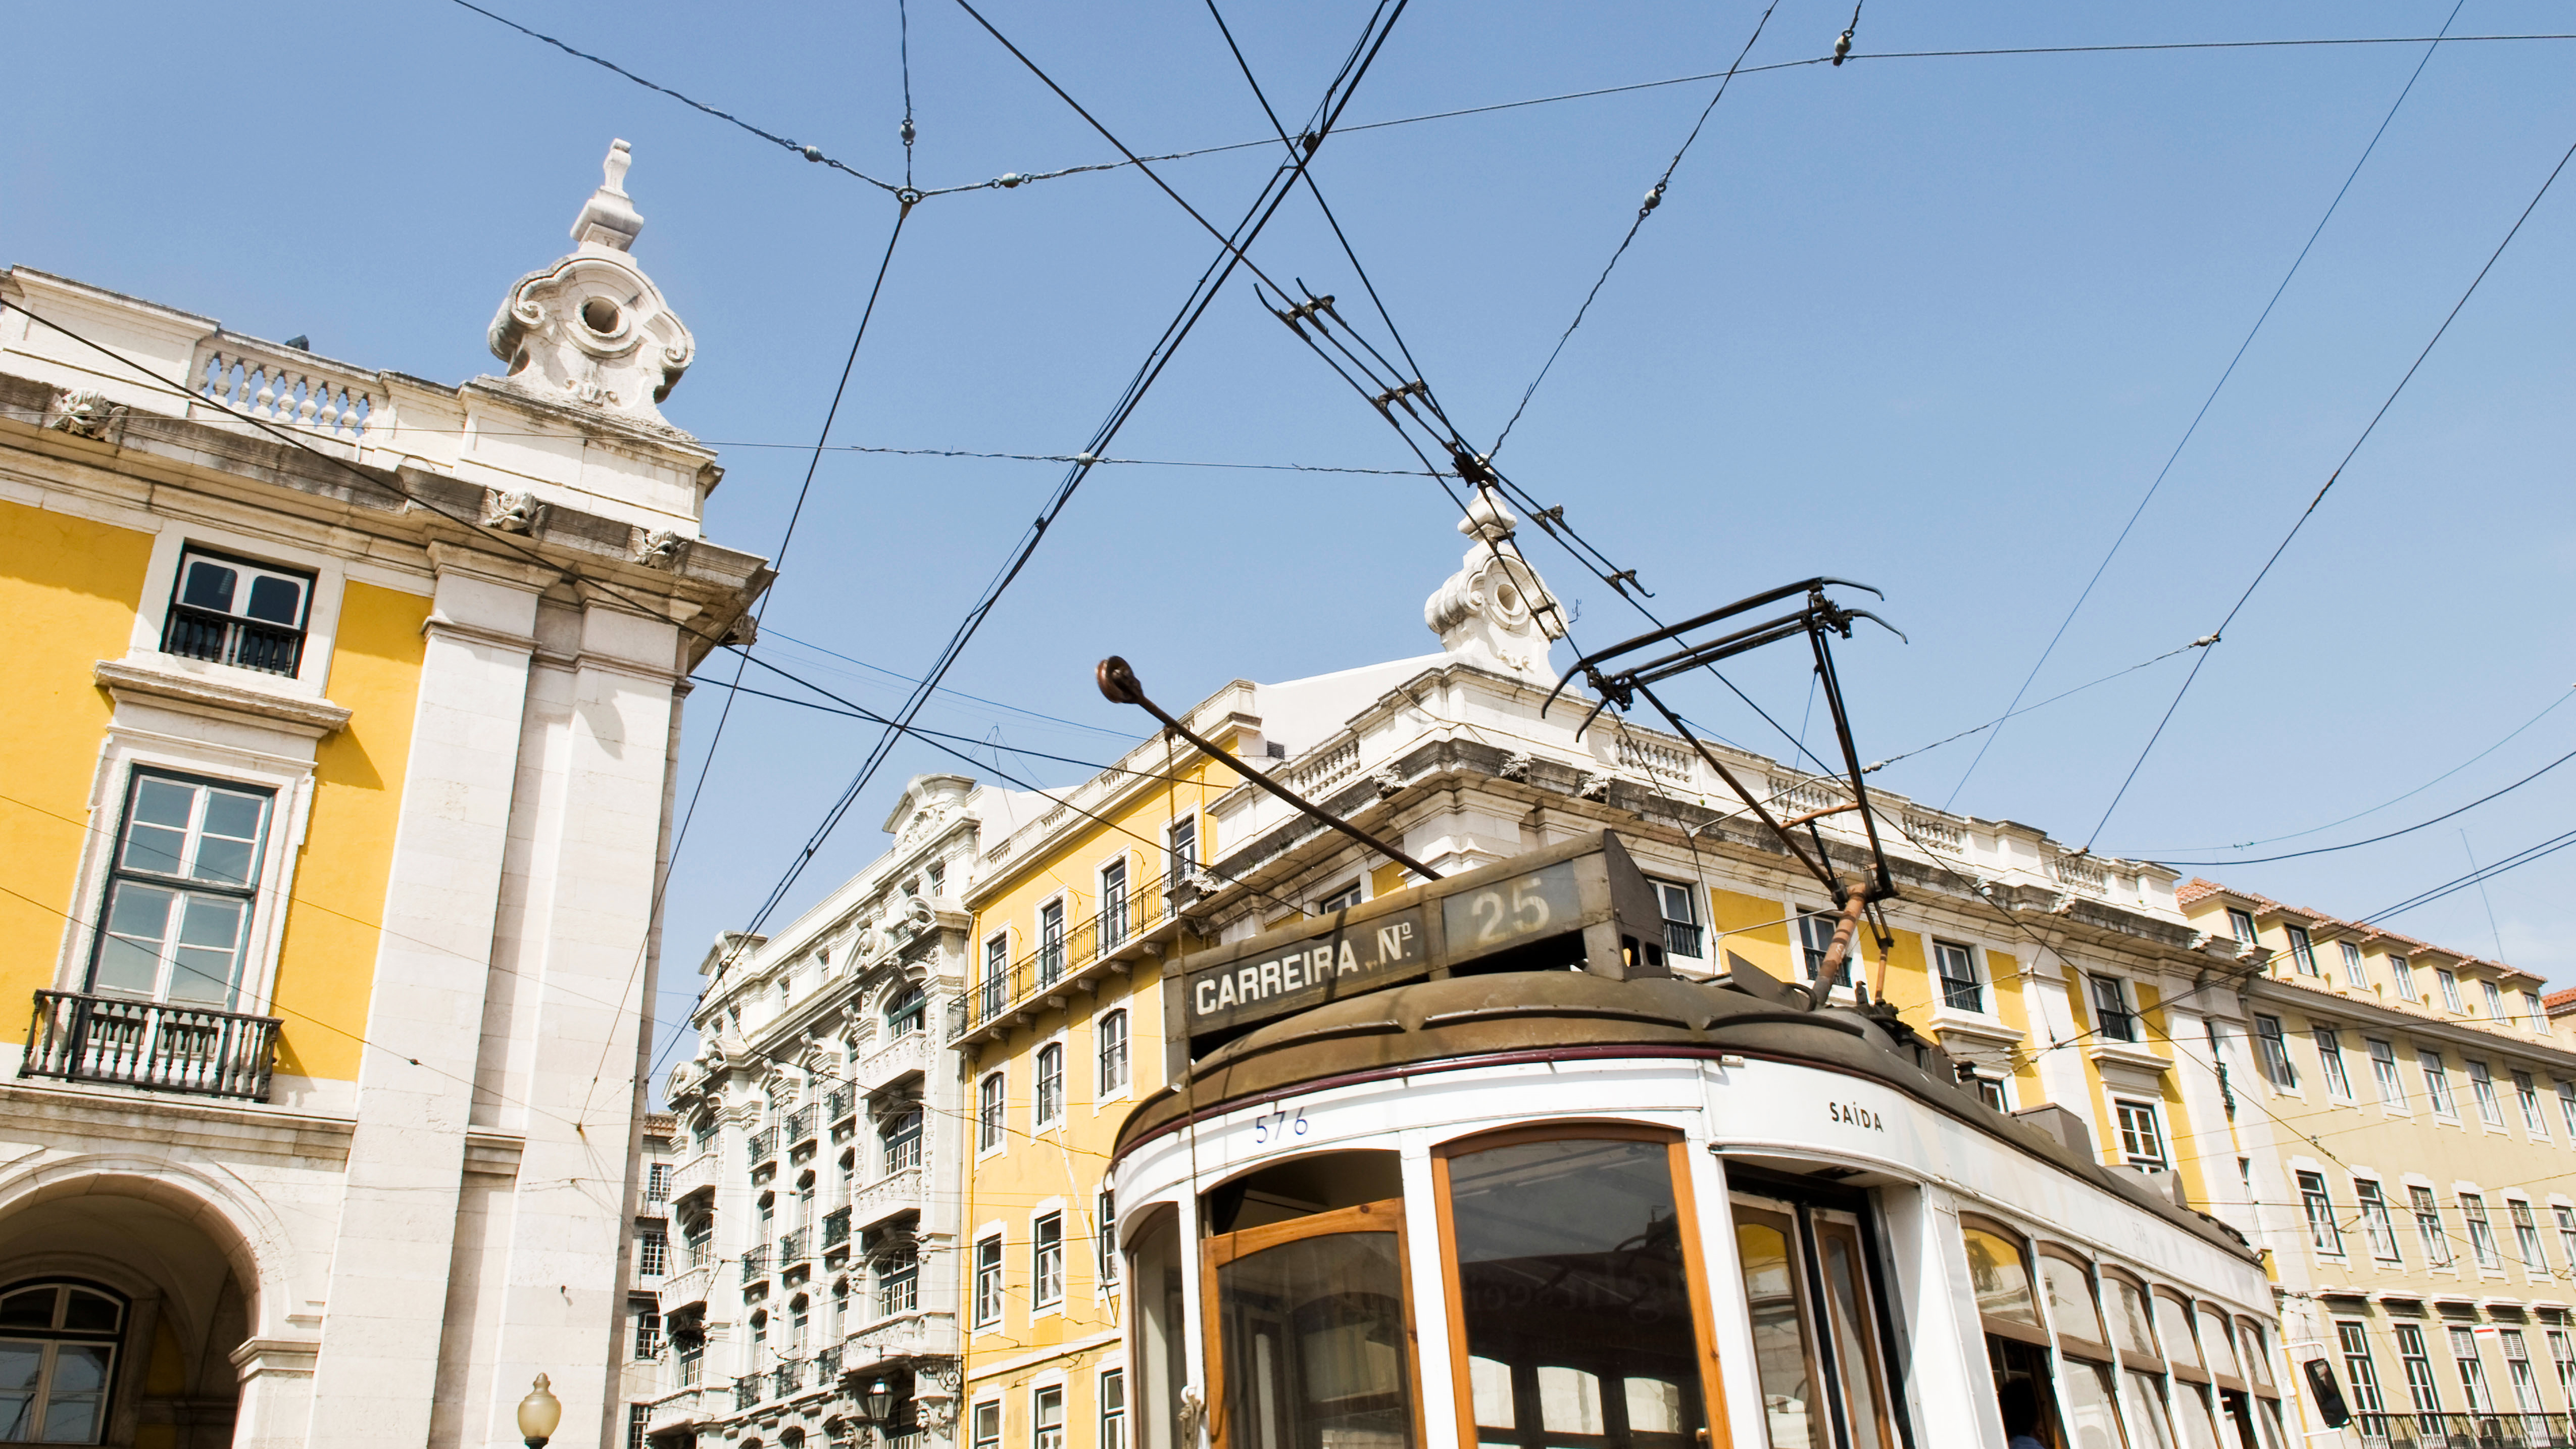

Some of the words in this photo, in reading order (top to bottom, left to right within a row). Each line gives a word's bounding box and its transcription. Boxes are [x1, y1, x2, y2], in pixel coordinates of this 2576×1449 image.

[1196, 939, 1358, 1015] CARREIRA
[1472, 878, 1549, 942] 25
[1256, 1107, 1308, 1143] 576
[1829, 1101, 1884, 1132] SAÍDA
